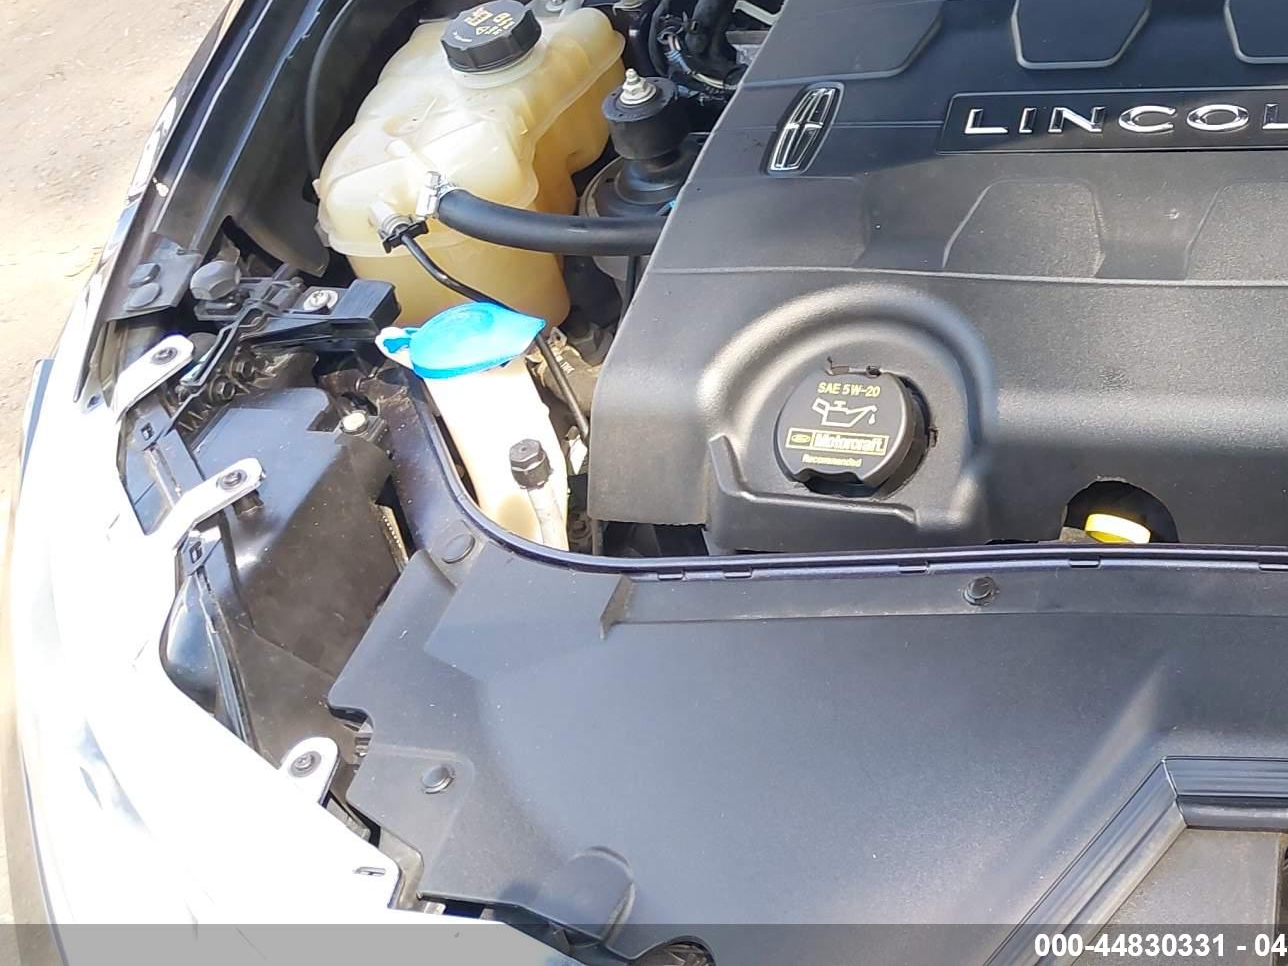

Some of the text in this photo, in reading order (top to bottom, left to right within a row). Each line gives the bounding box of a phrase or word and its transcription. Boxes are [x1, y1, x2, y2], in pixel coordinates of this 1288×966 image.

[818, 382, 881, 397] SAE 5W-20
[802, 454, 863, 467] Recommended
